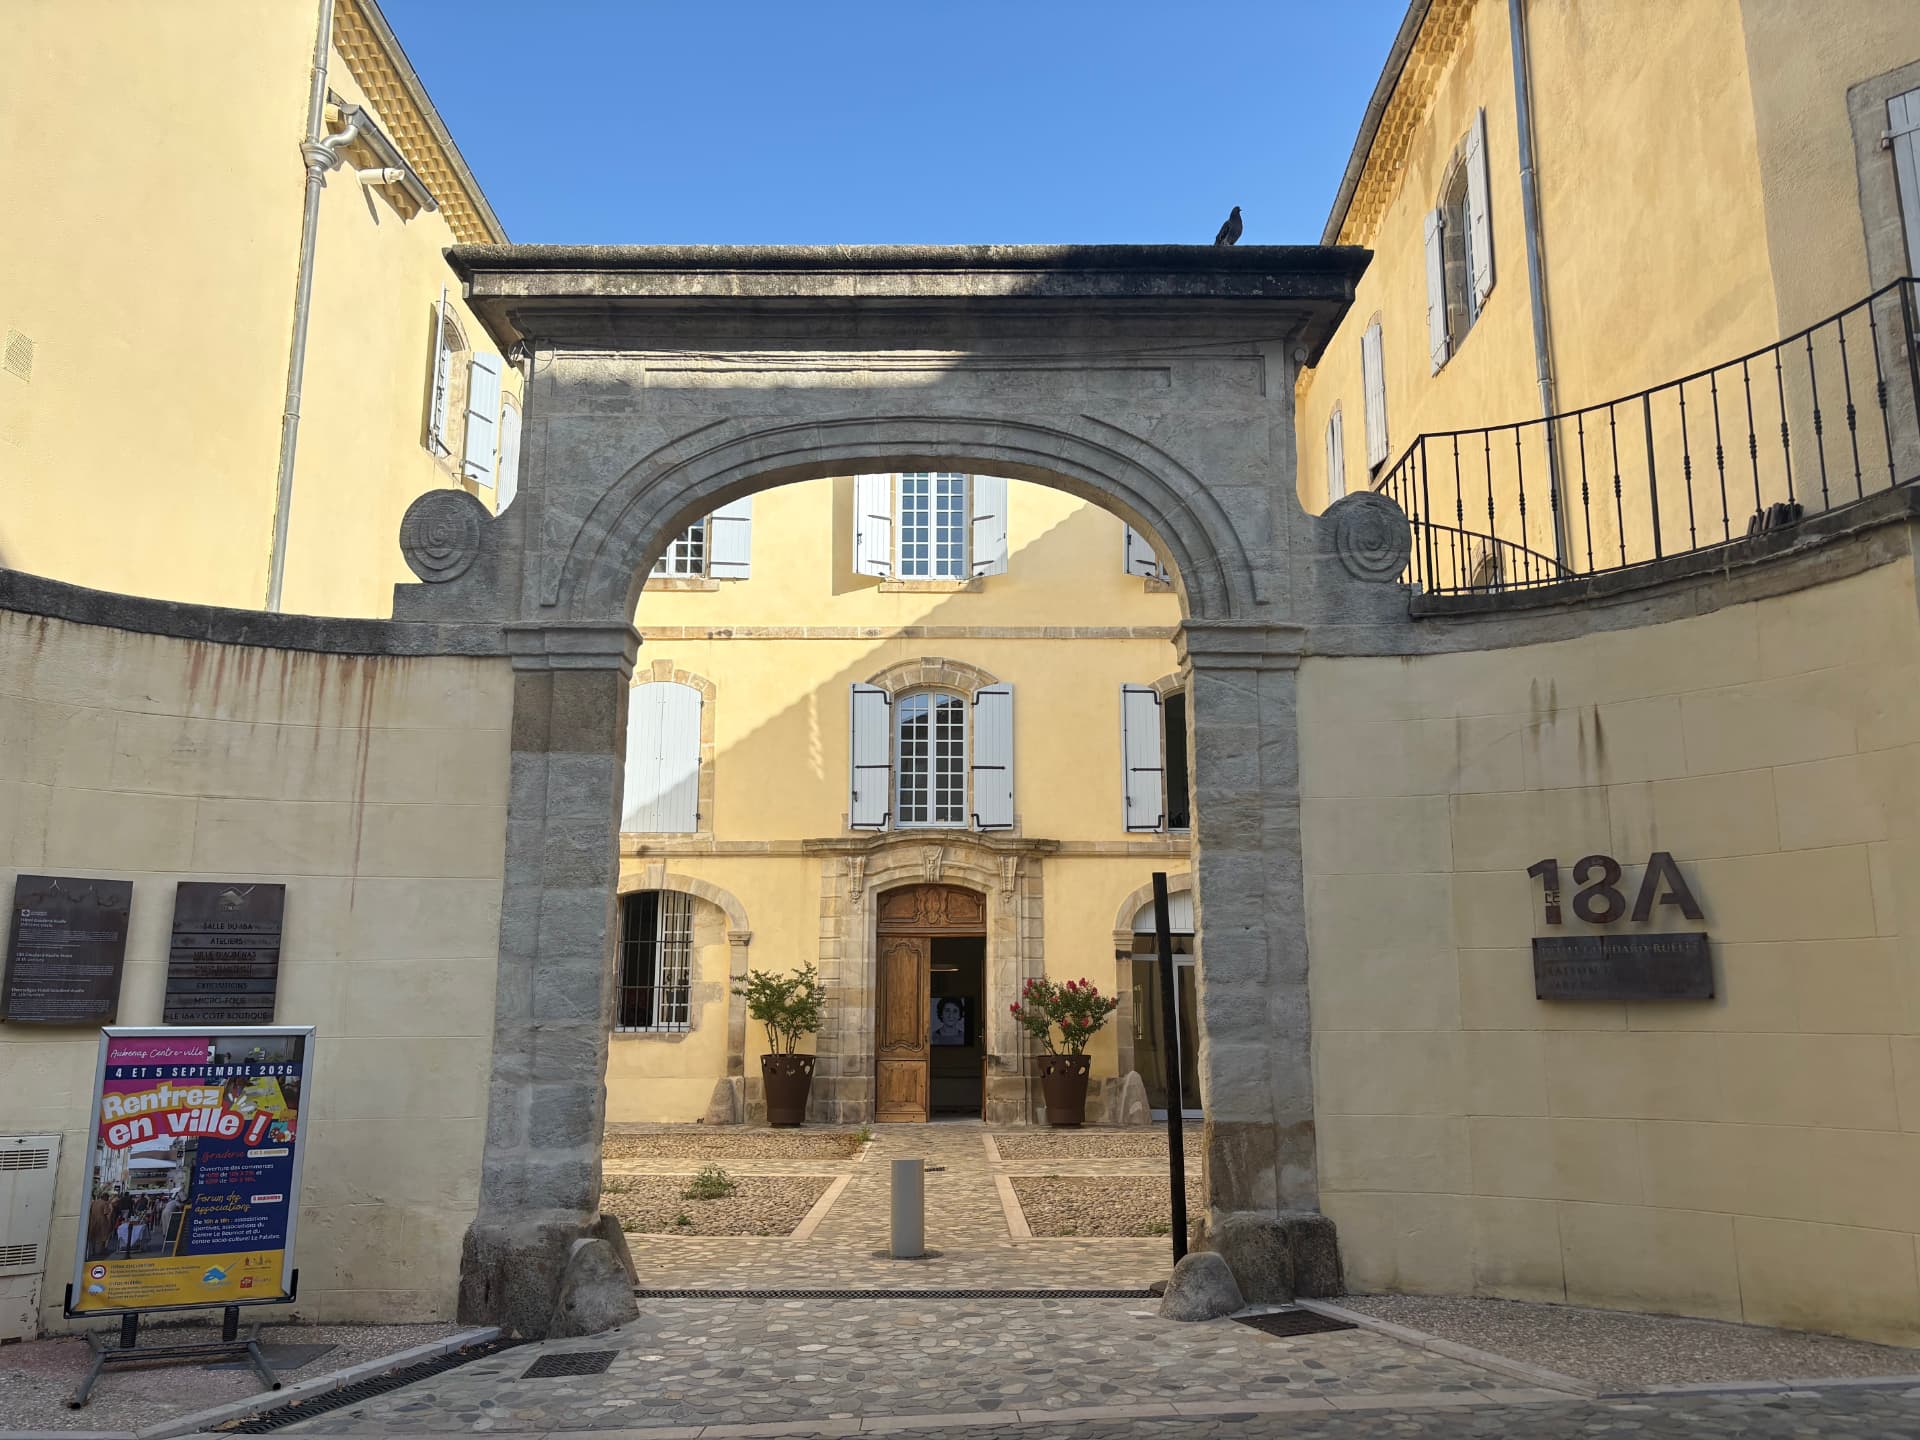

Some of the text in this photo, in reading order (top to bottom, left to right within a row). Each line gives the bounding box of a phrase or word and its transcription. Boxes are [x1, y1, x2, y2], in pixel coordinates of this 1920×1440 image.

[1527, 852, 1704, 924] 18A
[210, 937, 243, 945] ATELIERS
[111, 1046, 204, 1058] Aubenas Centre-ville
[115, 1065, 293, 1077] 4 ET 5 SEPTEMBRE 2026
[103, 1086, 219, 1119] Rentrez
[109, 1107, 267, 1145] en ville !
[196, 1193, 224, 1204] Forum
[194, 1202, 251, 1214] associations
